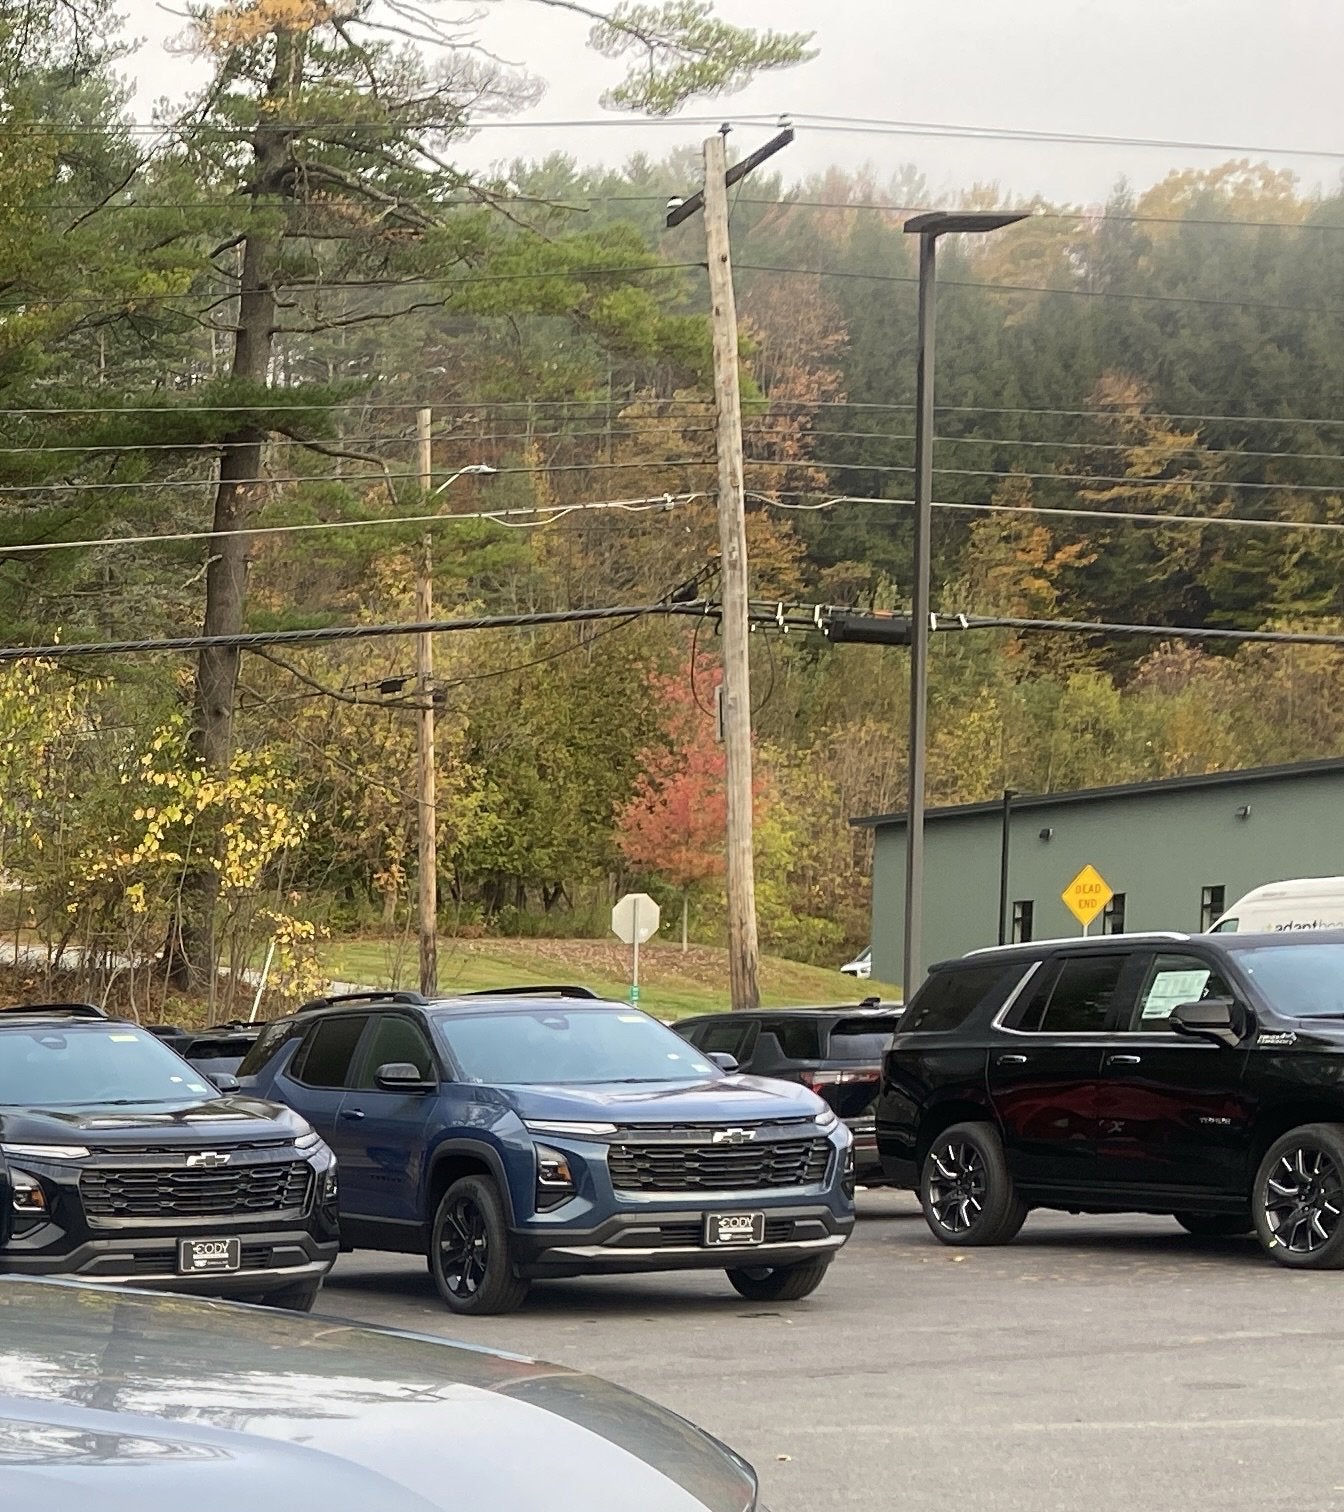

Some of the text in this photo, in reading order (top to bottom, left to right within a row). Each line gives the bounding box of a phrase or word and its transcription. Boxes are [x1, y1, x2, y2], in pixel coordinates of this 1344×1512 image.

[1075, 883, 1102, 895] DEAD
[1078, 898, 1098, 909] END
[720, 1217, 753, 1228] CODY
[195, 1242, 229, 1254] CODY
